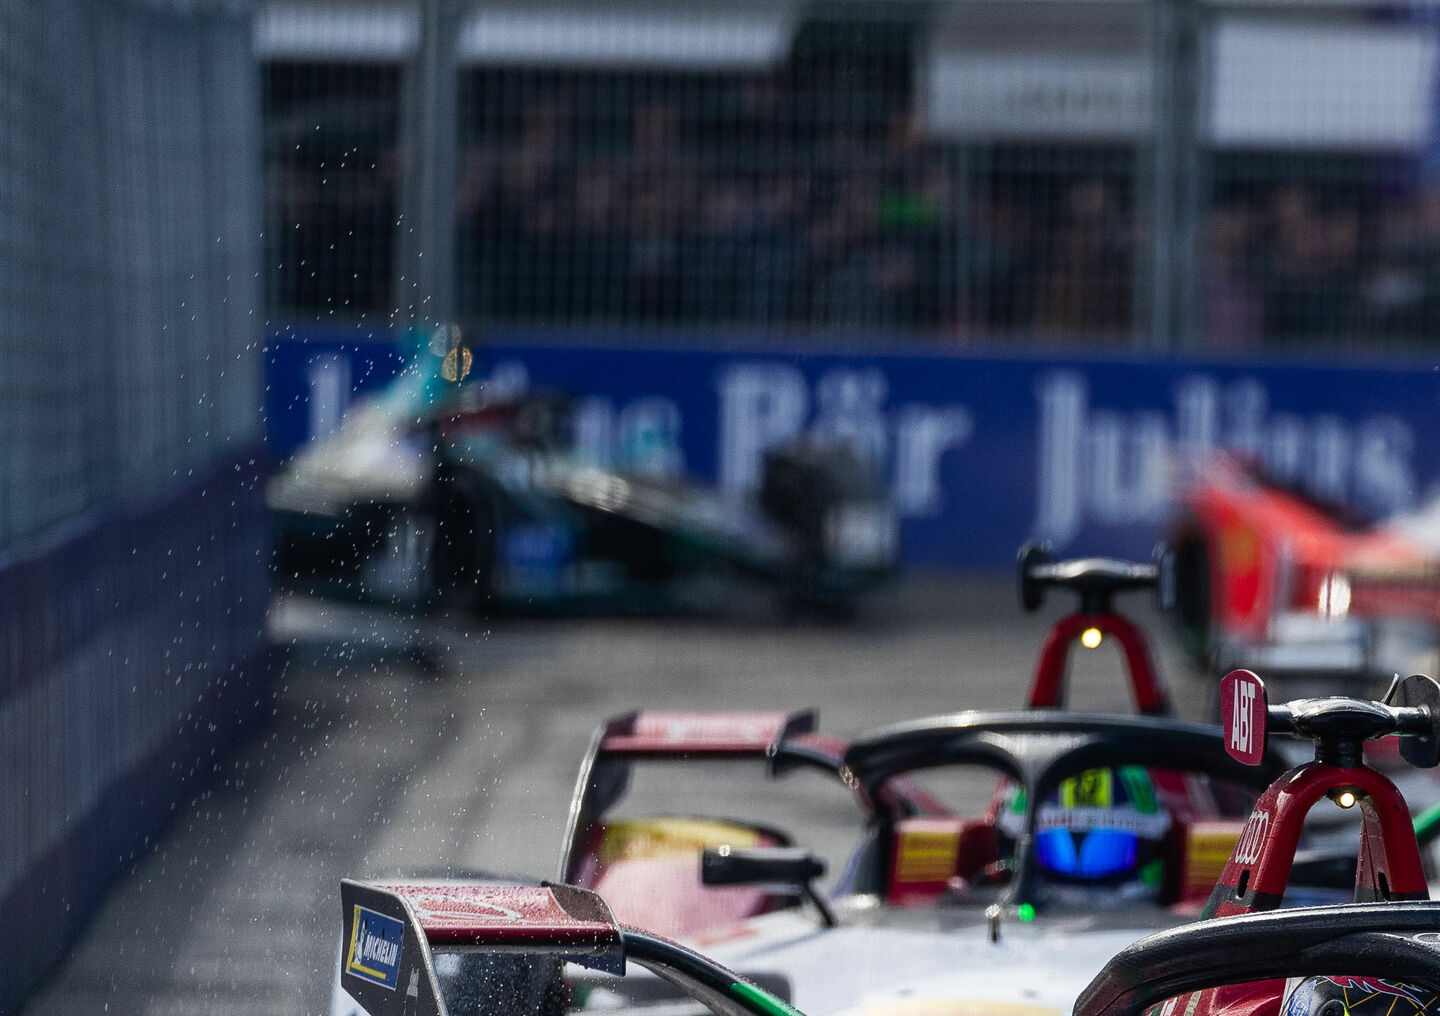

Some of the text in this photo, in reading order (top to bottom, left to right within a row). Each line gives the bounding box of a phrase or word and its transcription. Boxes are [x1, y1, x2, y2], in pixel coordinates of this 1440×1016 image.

[1020, 372, 1418, 545] Julius
[1231, 678, 1256, 754] ABT
[362, 932, 399, 967] MICHELIN
